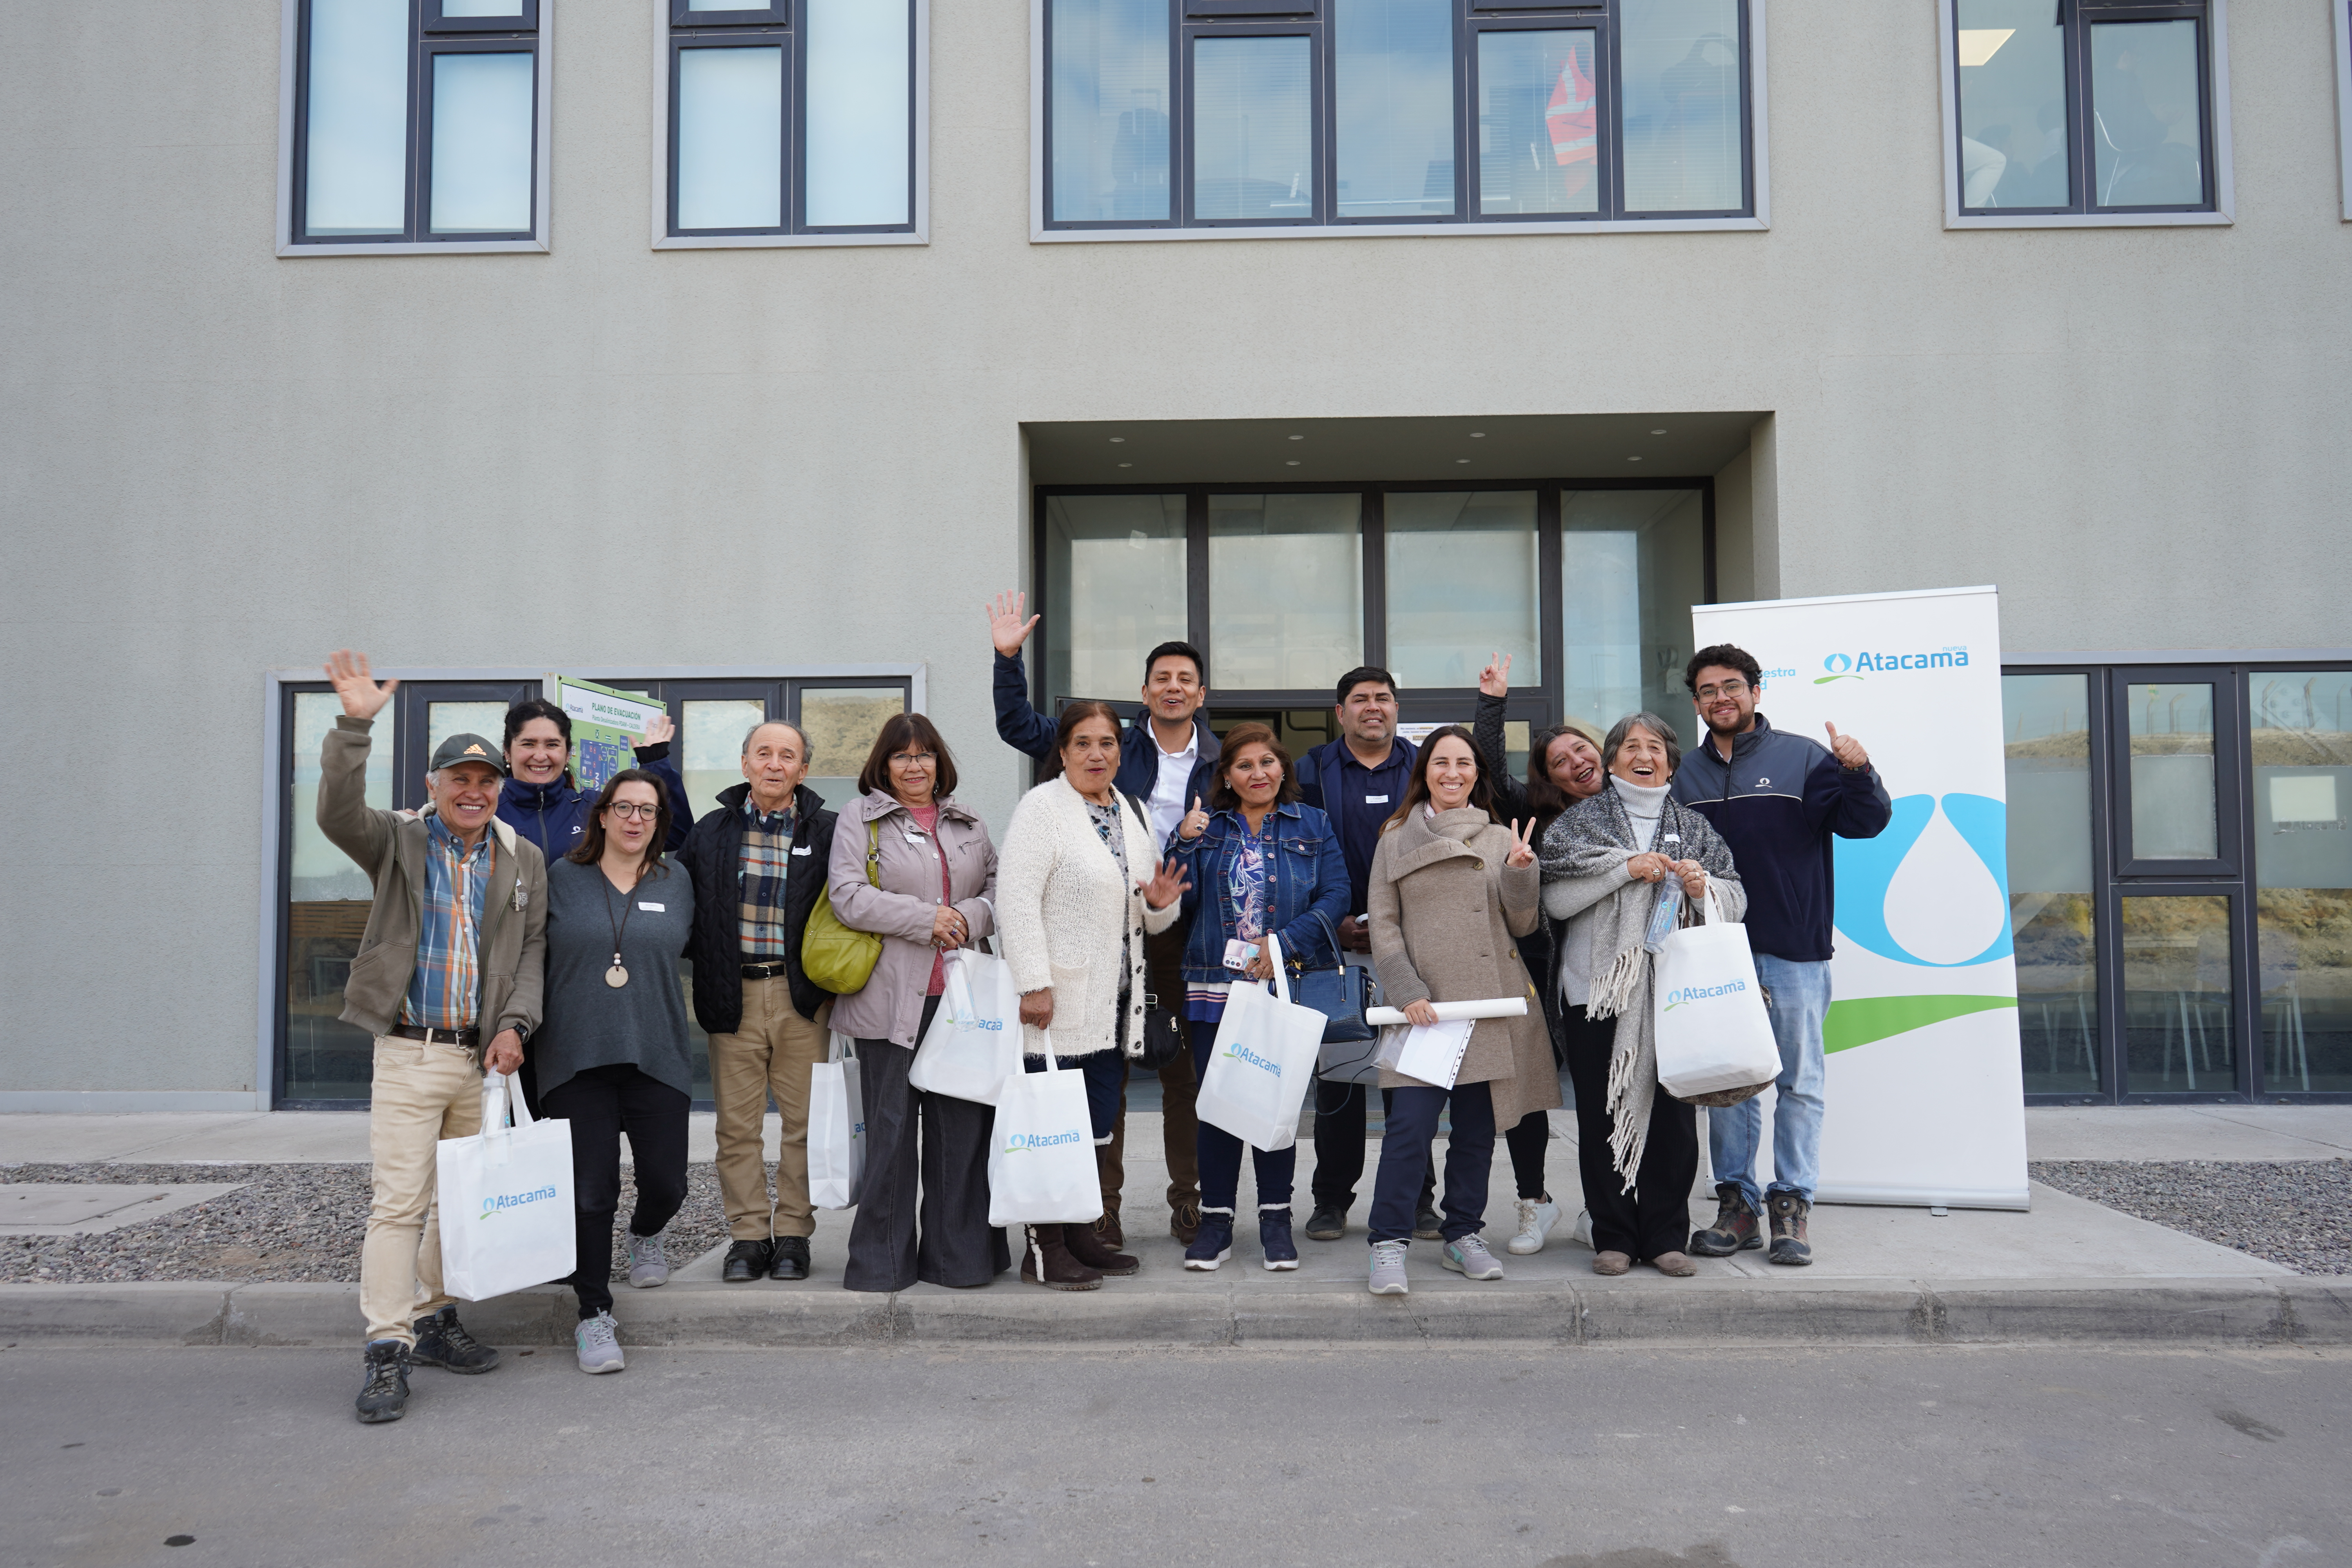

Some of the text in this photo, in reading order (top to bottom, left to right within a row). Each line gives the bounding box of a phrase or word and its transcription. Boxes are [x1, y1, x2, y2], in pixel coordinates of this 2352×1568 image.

[1856, 652, 1969, 672] Atacama
[1762, 667, 1796, 678] estra
[570, 704, 583, 713] Atacama
[592, 702, 641, 720] PLANO DE EVACUACIÓN
[1664, 902, 1677, 931] Atacama
[1683, 981, 1746, 1001] Atacama
[1240, 1047, 1281, 1078] Atacama
[1027, 1132, 1080, 1147] Atacama
[496, 1188, 556, 1210] Atacama
